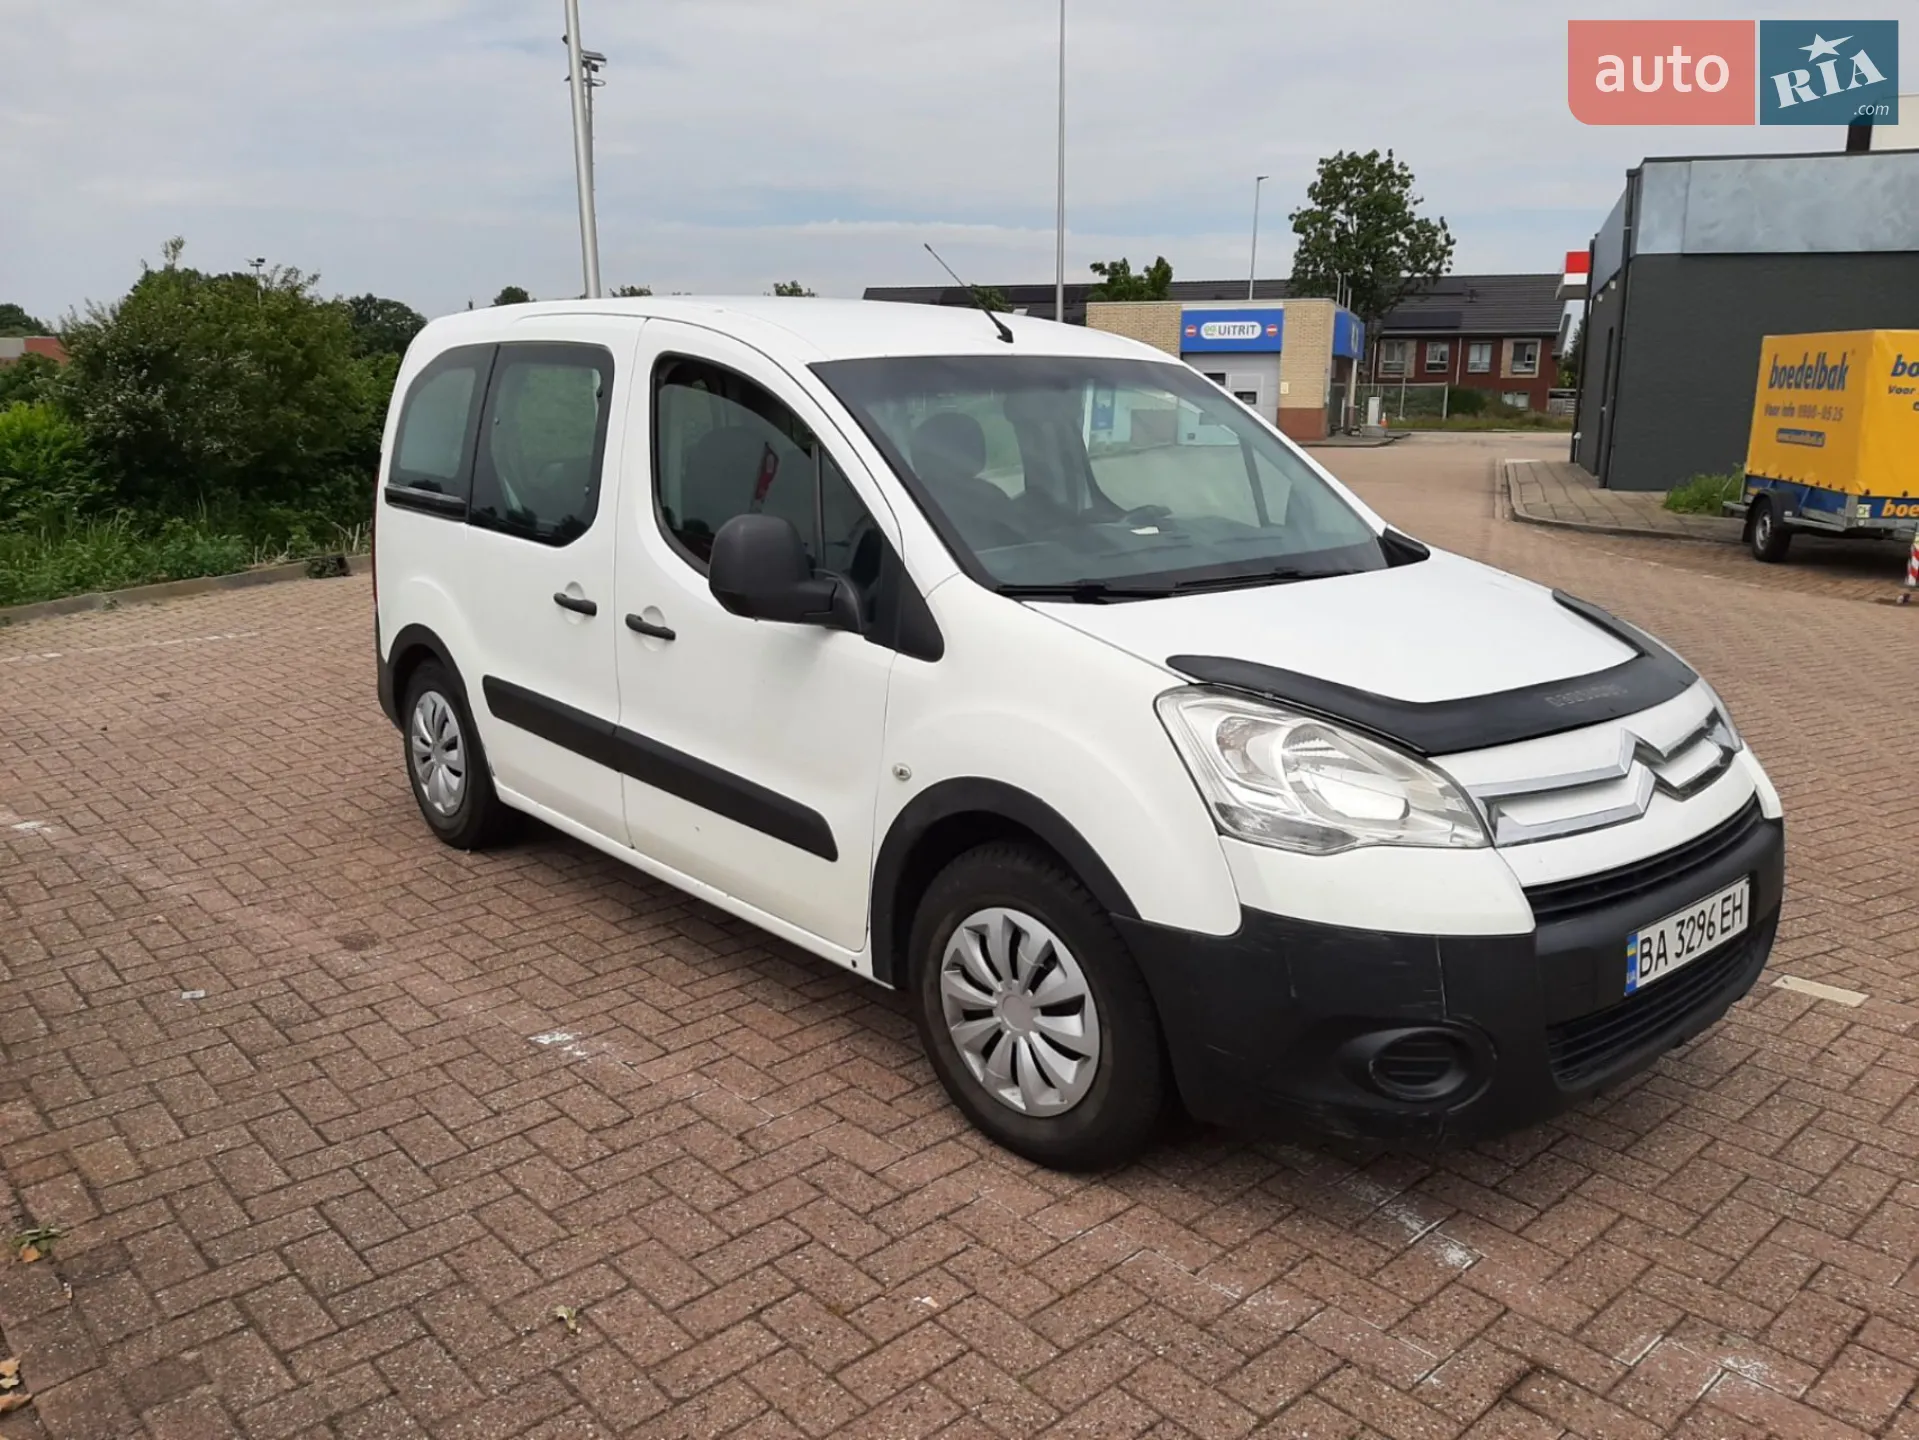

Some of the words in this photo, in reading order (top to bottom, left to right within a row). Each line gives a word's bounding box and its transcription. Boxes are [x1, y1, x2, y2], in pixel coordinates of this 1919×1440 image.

[1218, 324, 1257, 336] UITRIT
[1768, 351, 1849, 391] boedelbak
[1640, 929, 1668, 978] BA
[1674, 902, 1716, 959] 3296
[1720, 888, 1744, 935] EH
